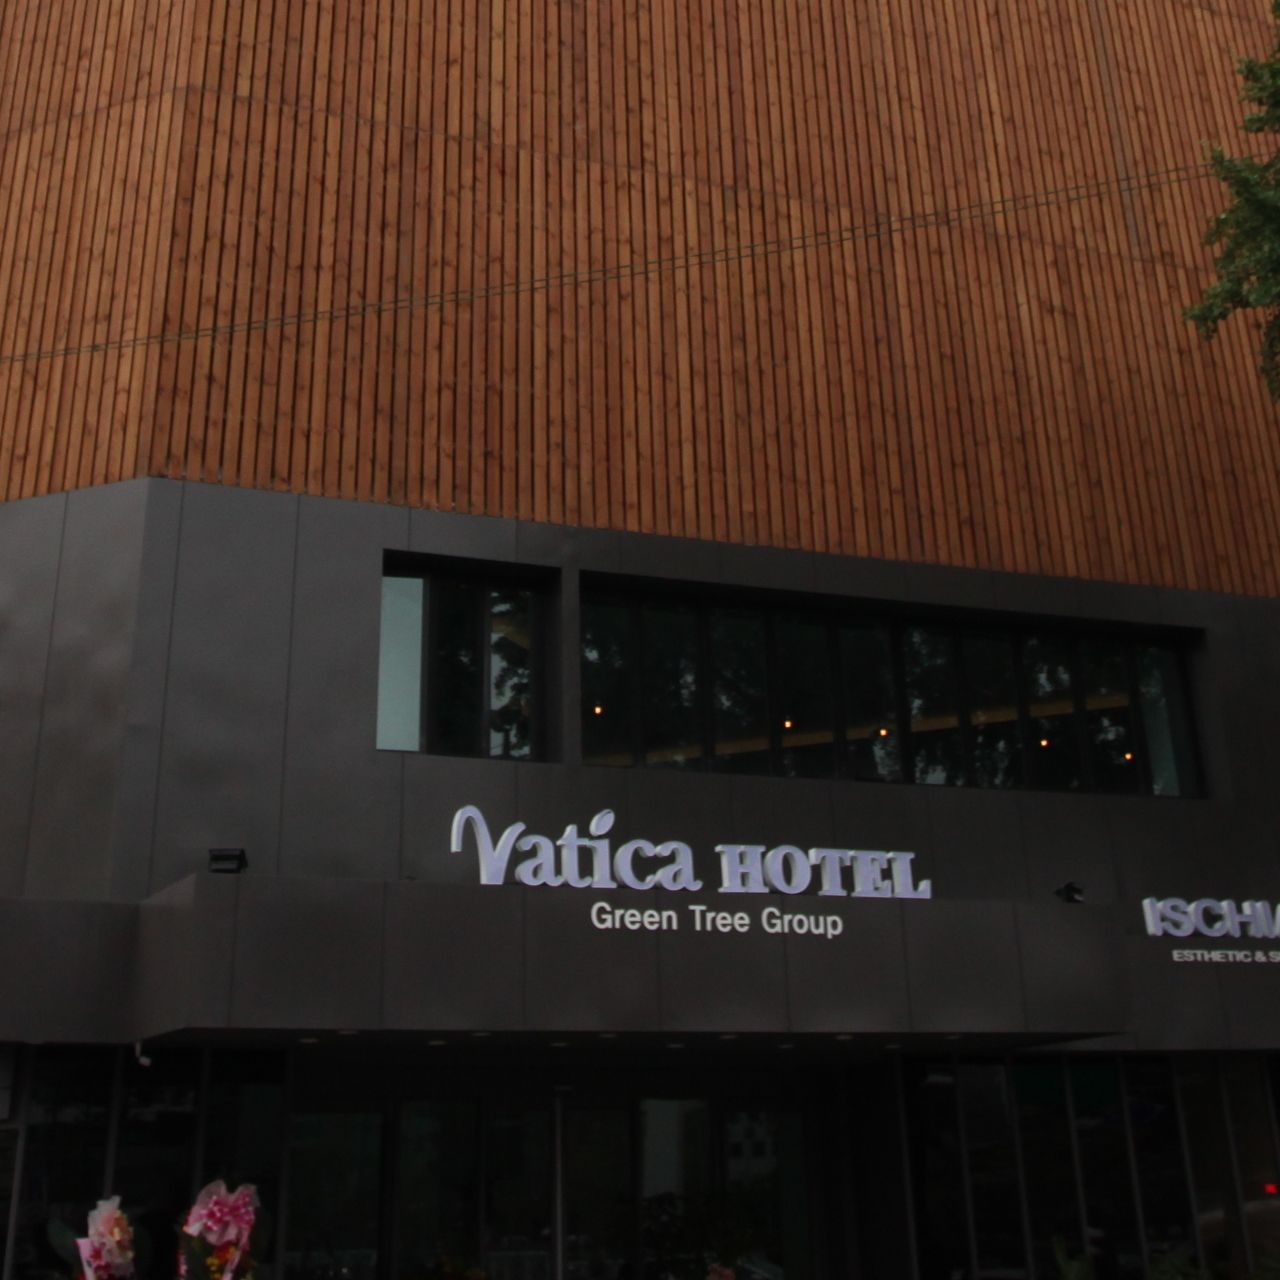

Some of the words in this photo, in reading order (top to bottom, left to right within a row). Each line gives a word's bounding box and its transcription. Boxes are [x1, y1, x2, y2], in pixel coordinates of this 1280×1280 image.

[450, 805, 702, 891] Vatica
[715, 844, 931, 899] HOTEL
[591, 901, 677, 931] Green
[688, 905, 750, 932] Tree
[761, 908, 842, 938] Group
[1172, 949, 1252, 962] ESTHETIC
[1255, 950, 1267, 963] &
